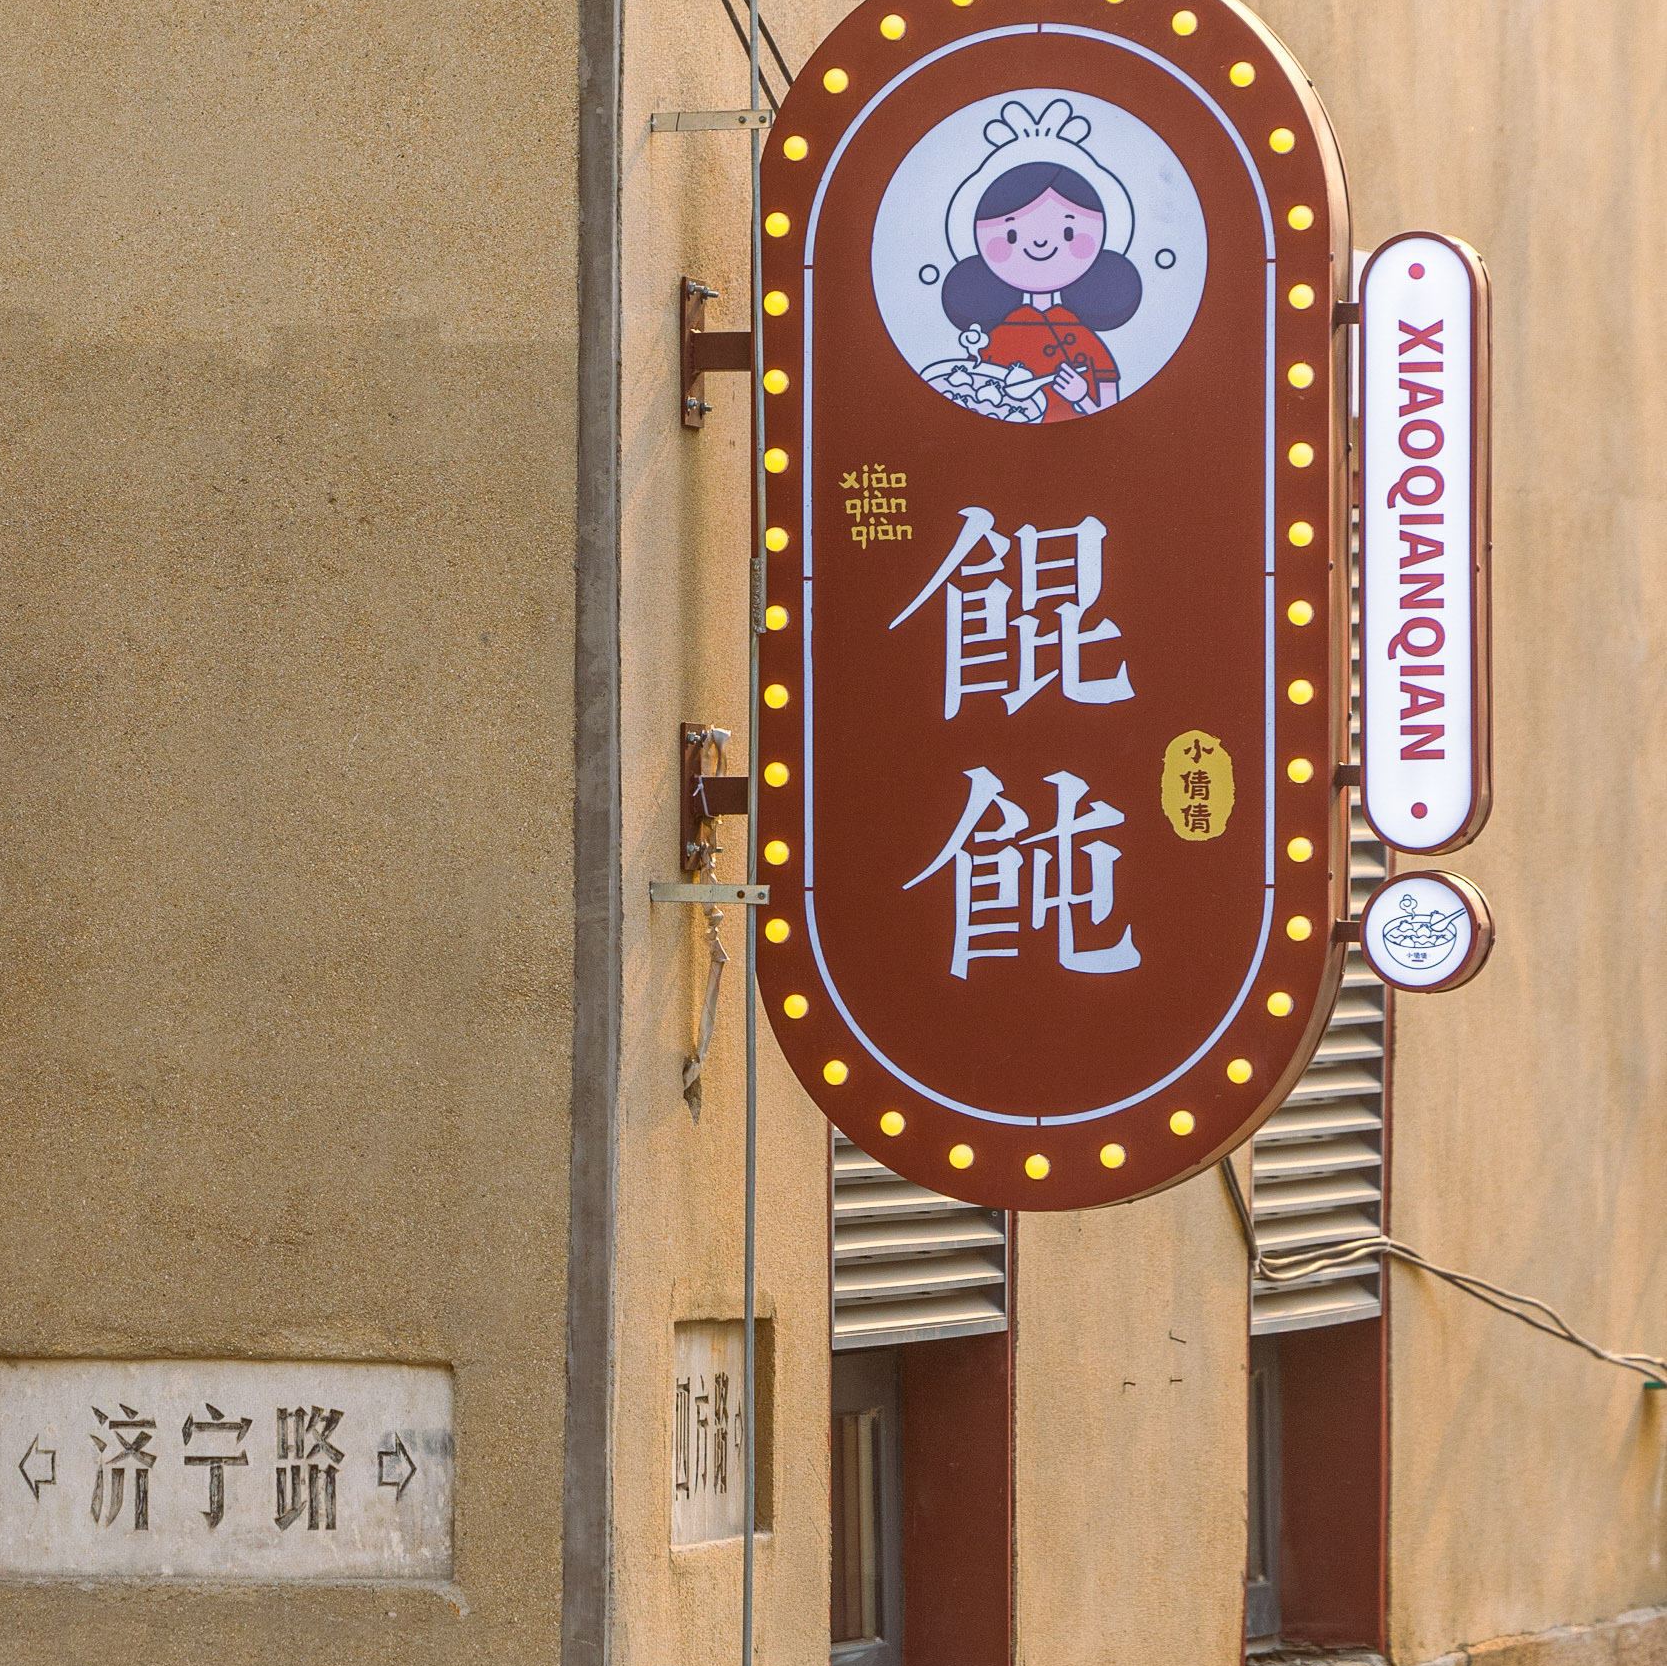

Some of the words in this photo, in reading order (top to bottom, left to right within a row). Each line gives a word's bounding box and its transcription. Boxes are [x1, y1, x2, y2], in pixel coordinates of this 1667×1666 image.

[838, 463, 907, 489] xiǎo
[845, 489, 907, 523] qiàn
[851, 517, 912, 550] qiàn
[1387, 319, 1446, 761] XIAOQIANQIAN
[888, 507, 1141, 981] 餛飩
[1179, 738, 1212, 834] 小倩倩
[89, 1401, 346, 1532] 济宁路
